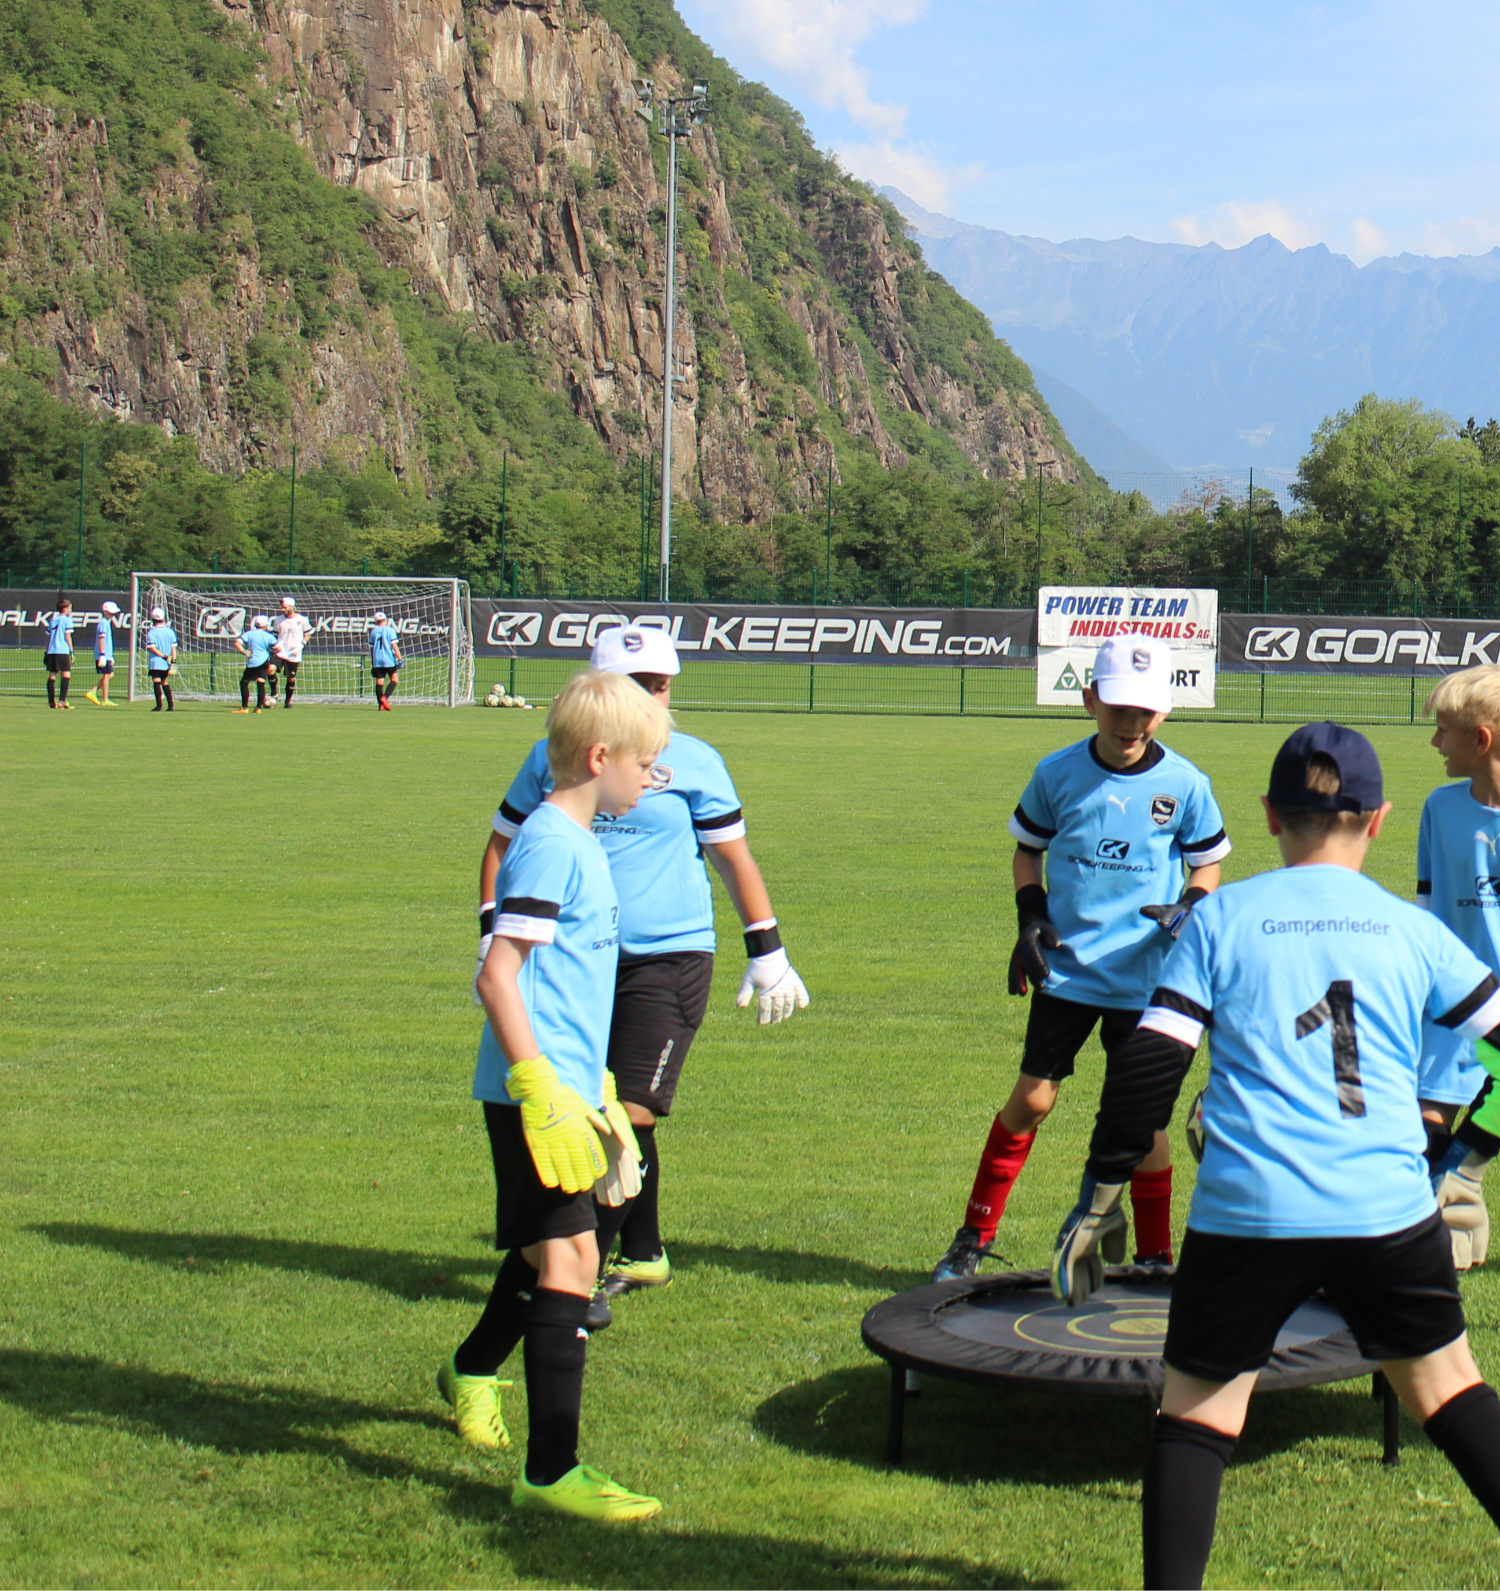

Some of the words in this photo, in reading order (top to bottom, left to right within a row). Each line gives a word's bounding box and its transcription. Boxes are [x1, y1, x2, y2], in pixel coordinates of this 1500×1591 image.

[1045, 596, 1124, 615] POWER
[1130, 598, 1189, 617] TEAM
[1070, 620, 1196, 639] INDUSTRIALS
[1262, 917, 1390, 937] Gampenrieder
[1295, 980, 1367, 1119] 1
